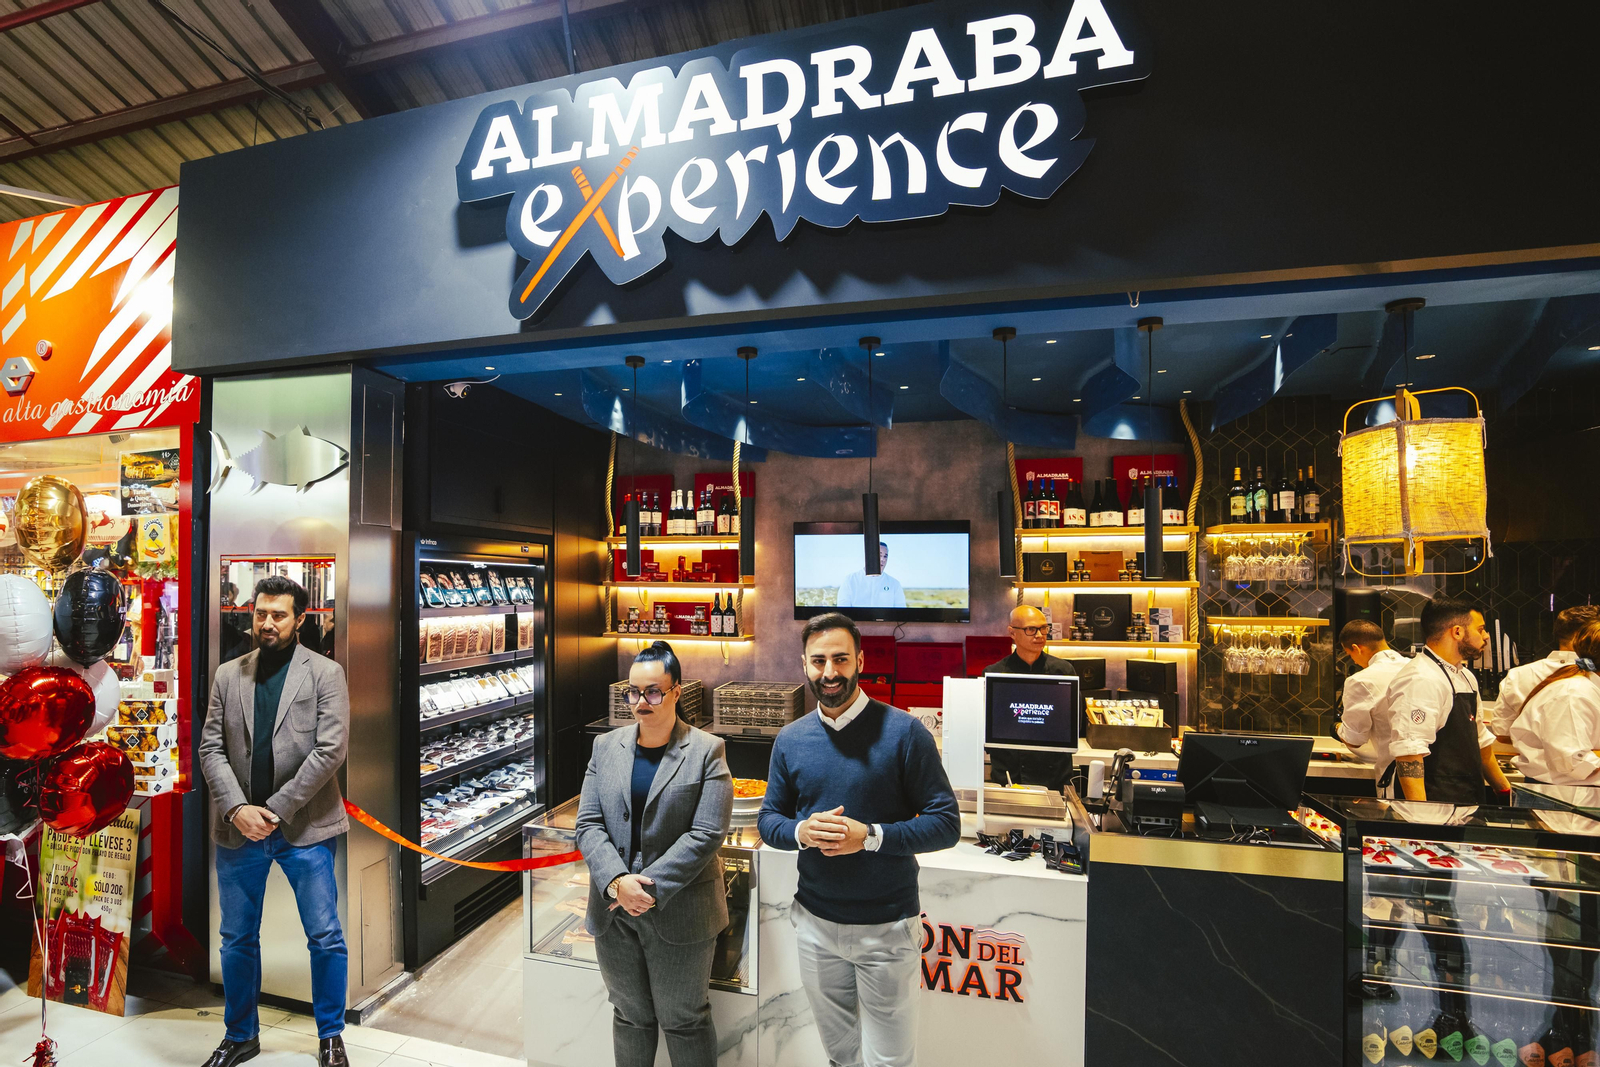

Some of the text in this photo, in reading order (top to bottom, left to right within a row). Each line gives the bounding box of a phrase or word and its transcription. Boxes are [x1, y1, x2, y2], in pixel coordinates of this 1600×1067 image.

[472, 0, 1135, 182] ALMADRABA
[3, 393, 47, 423] alta
[1010, 703, 1054, 711] ALMADRABA
[89, 832, 124, 851] LLÉVESE
[127, 838, 132, 852] 3
[114, 852, 131, 861] REGALO
[94, 880, 124, 896] SÓLO 20€
[104, 896, 110, 904] DE
[977, 941, 1025, 966] DEL
[920, 957, 1025, 1003] MAR
